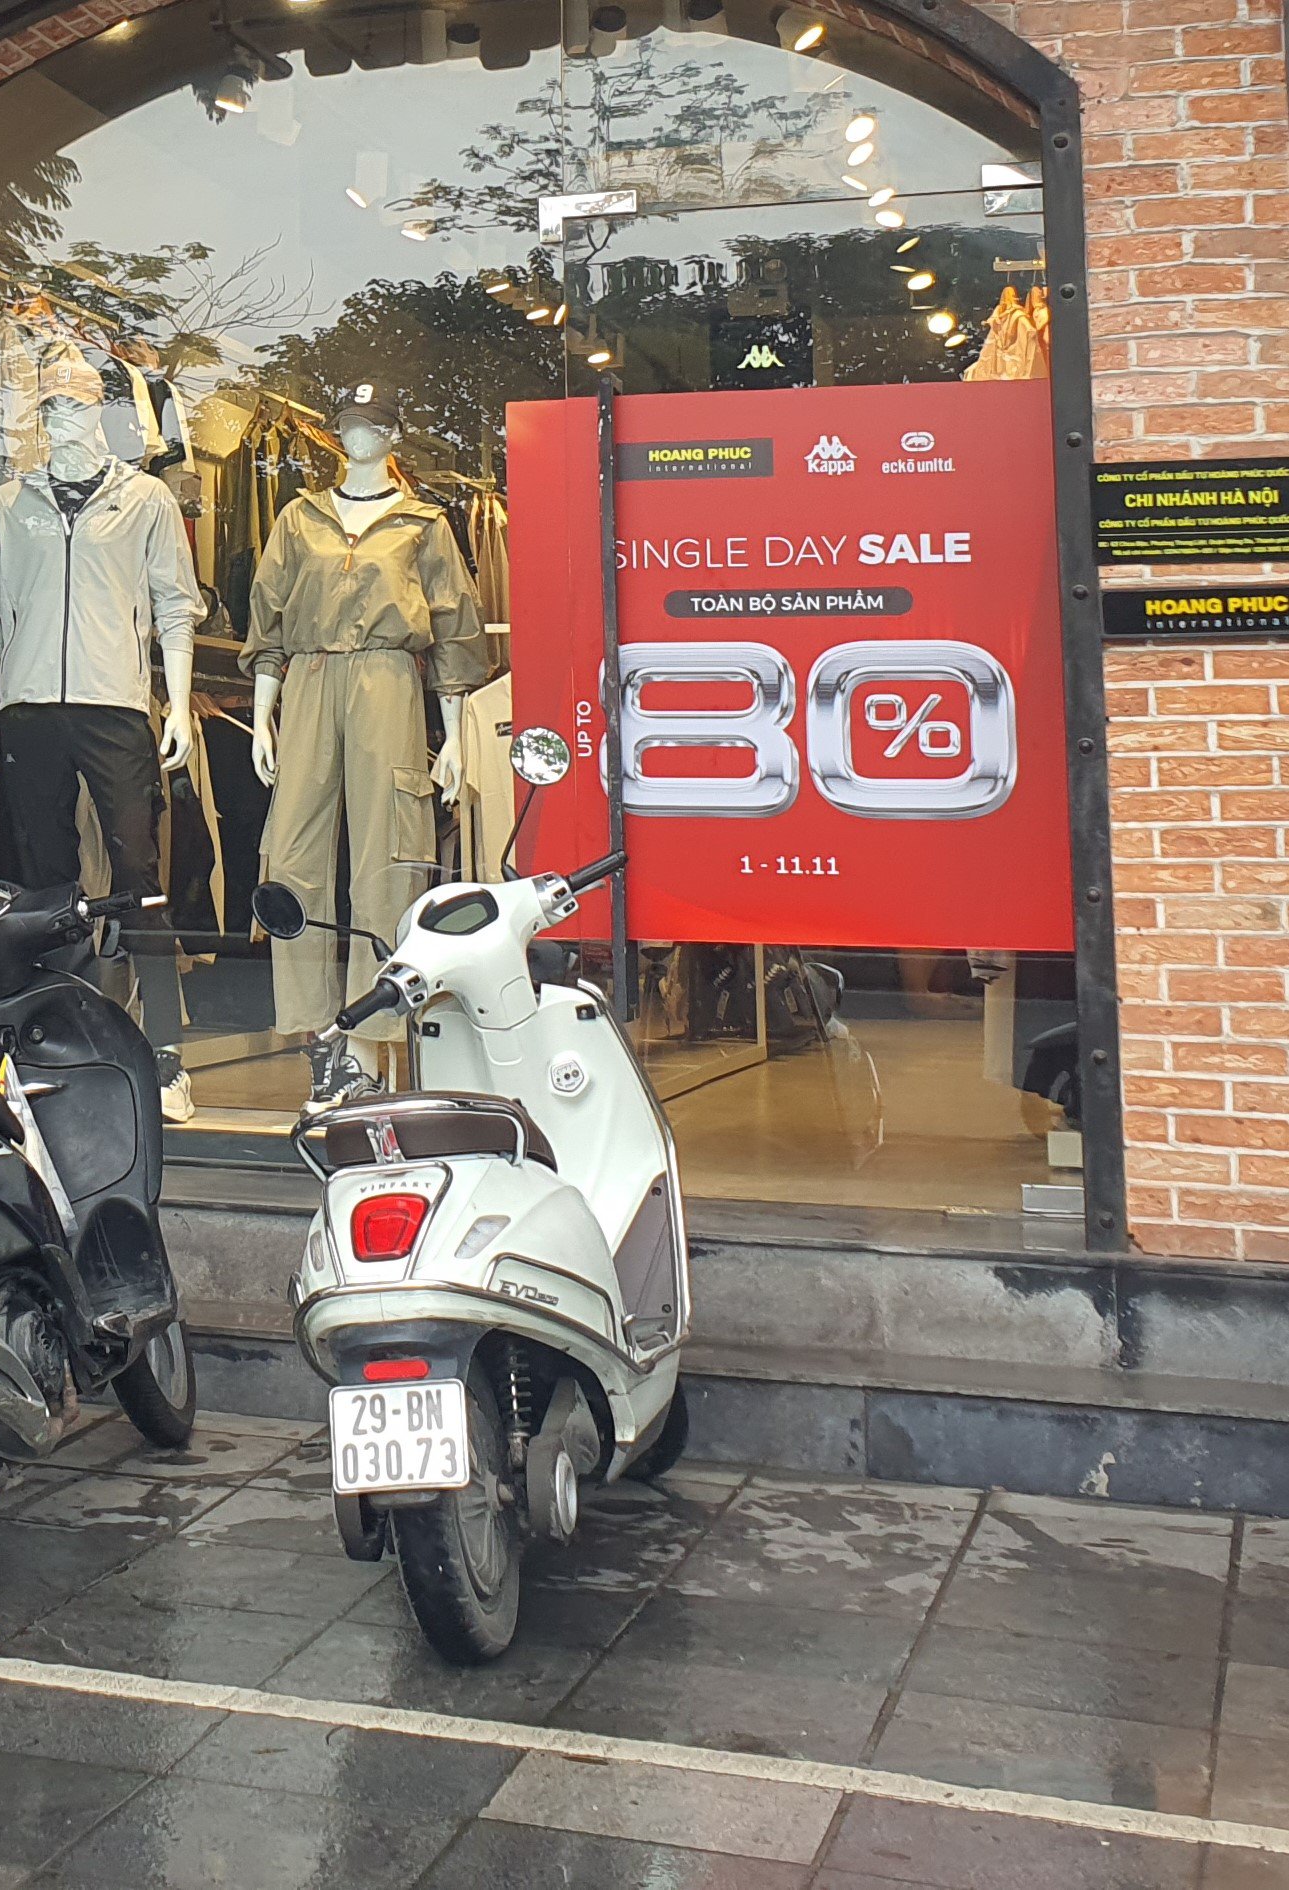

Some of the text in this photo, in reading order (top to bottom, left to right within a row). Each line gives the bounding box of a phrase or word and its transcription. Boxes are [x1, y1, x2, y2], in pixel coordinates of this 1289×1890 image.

[354, 384, 374, 403] 9
[648, 447, 752, 462] HOANG PHUC
[648, 461, 752, 473] international
[807, 459, 855, 476] Kappa
[1124, 486, 1280, 508] CHI NHÁNH HÀ NỘI
[614, 531, 972, 570] SINGLE DAY SALE
[690, 588, 883, 615] TOÀN BỘ SẢN PHẨM
[1145, 595, 1289, 615] HOANG PHUC
[576, 700, 593, 758] UP TO
[599, 639, 1018, 820] 80%
[740, 855, 754, 874] 1
[776, 856, 840, 875] 11.11
[360, 1181, 432, 1194] VINFAST
[351, 1388, 444, 1436] 29-BN
[342, 1437, 458, 1484] 030.73
